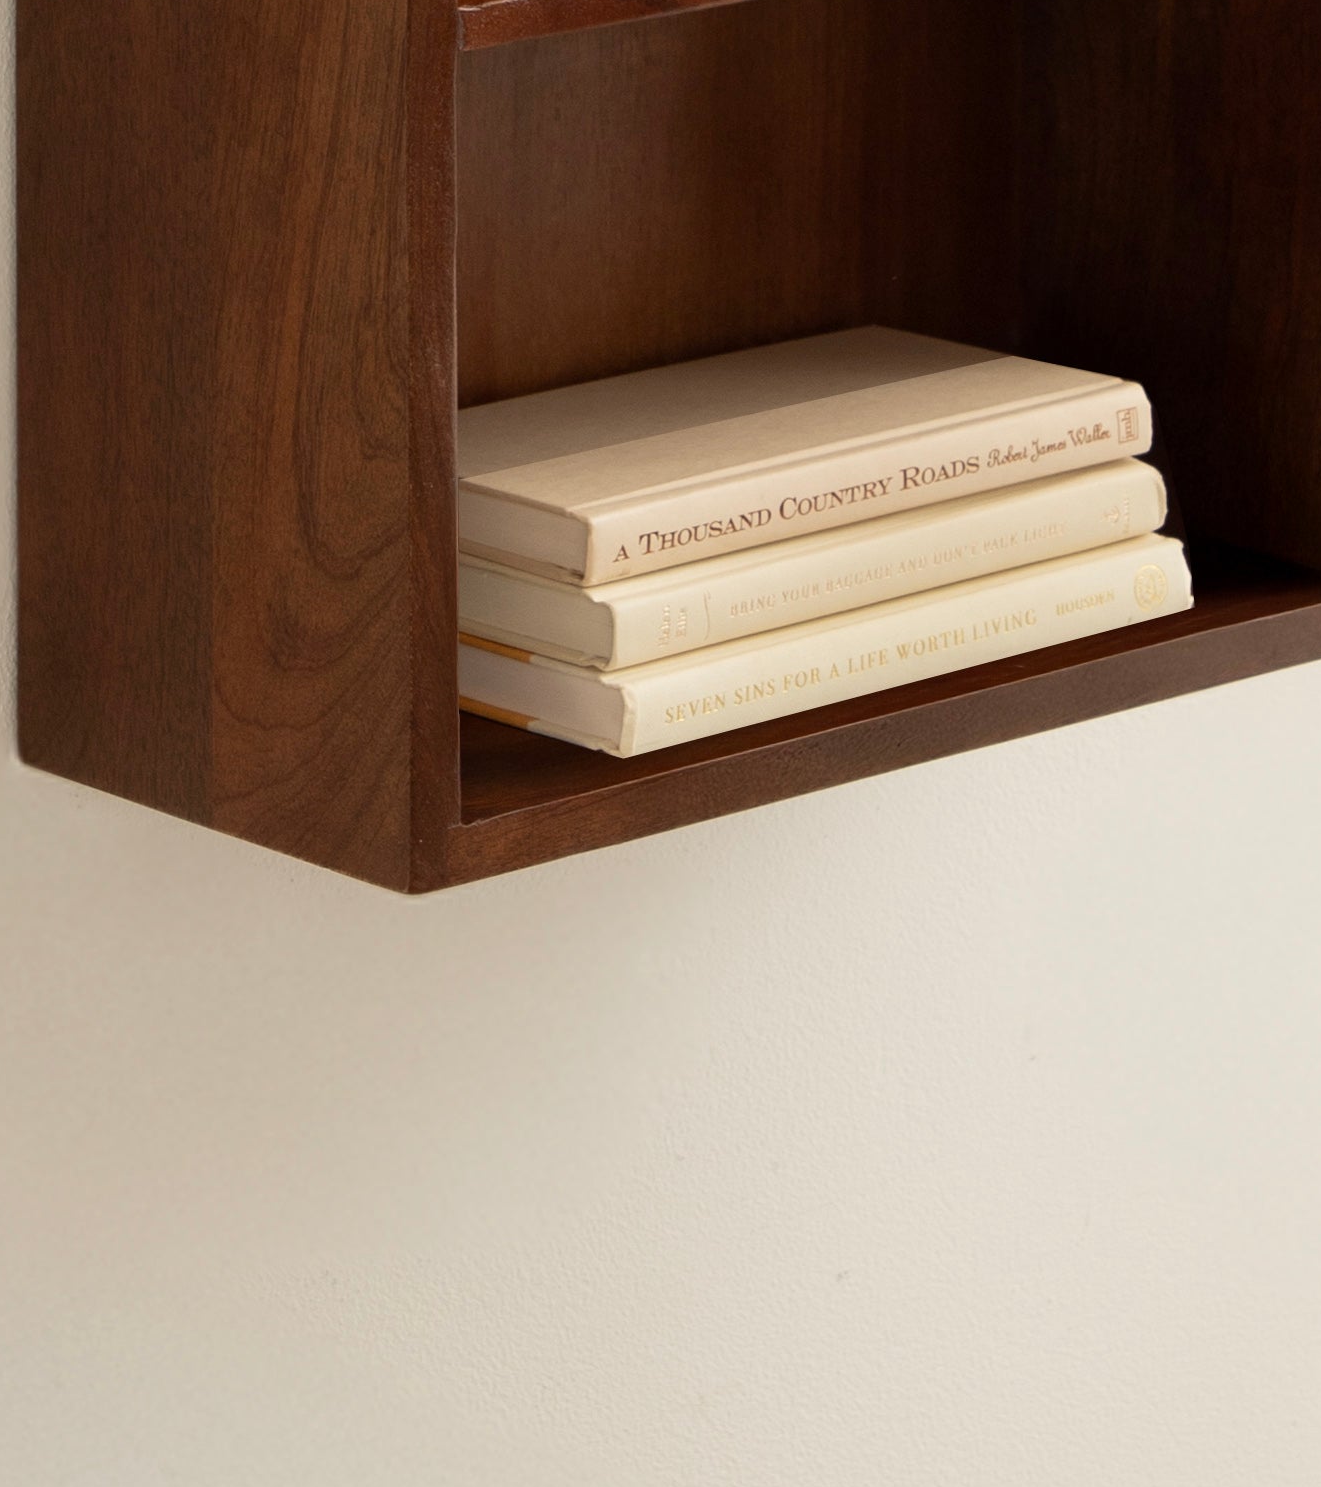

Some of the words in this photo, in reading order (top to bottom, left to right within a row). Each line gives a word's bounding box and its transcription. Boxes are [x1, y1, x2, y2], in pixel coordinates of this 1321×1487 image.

[986, 444, 1029, 470] Robert
[1030, 437, 1068, 463] James
[1067, 421, 1112, 447] Waller
[612, 545, 631, 563] A
[728, 592, 777, 618] BRING
[781, 582, 821, 605] YOUR
[825, 567, 894, 594] BAGGAGE
[897, 555, 928, 576] AND
[933, 543, 978, 566] DON'T
[982, 533, 1019, 555] PACK
[1023, 520, 1068, 544] LIGHT
[664, 694, 727, 725] SEVEN
[733, 679, 777, 707] SINS
[782, 668, 821, 694] FOR
[828, 663, 841, 680] A
[848, 649, 889, 674] LIFE
[896, 628, 966, 661] WORTH
[972, 608, 1039, 641] LIVING
